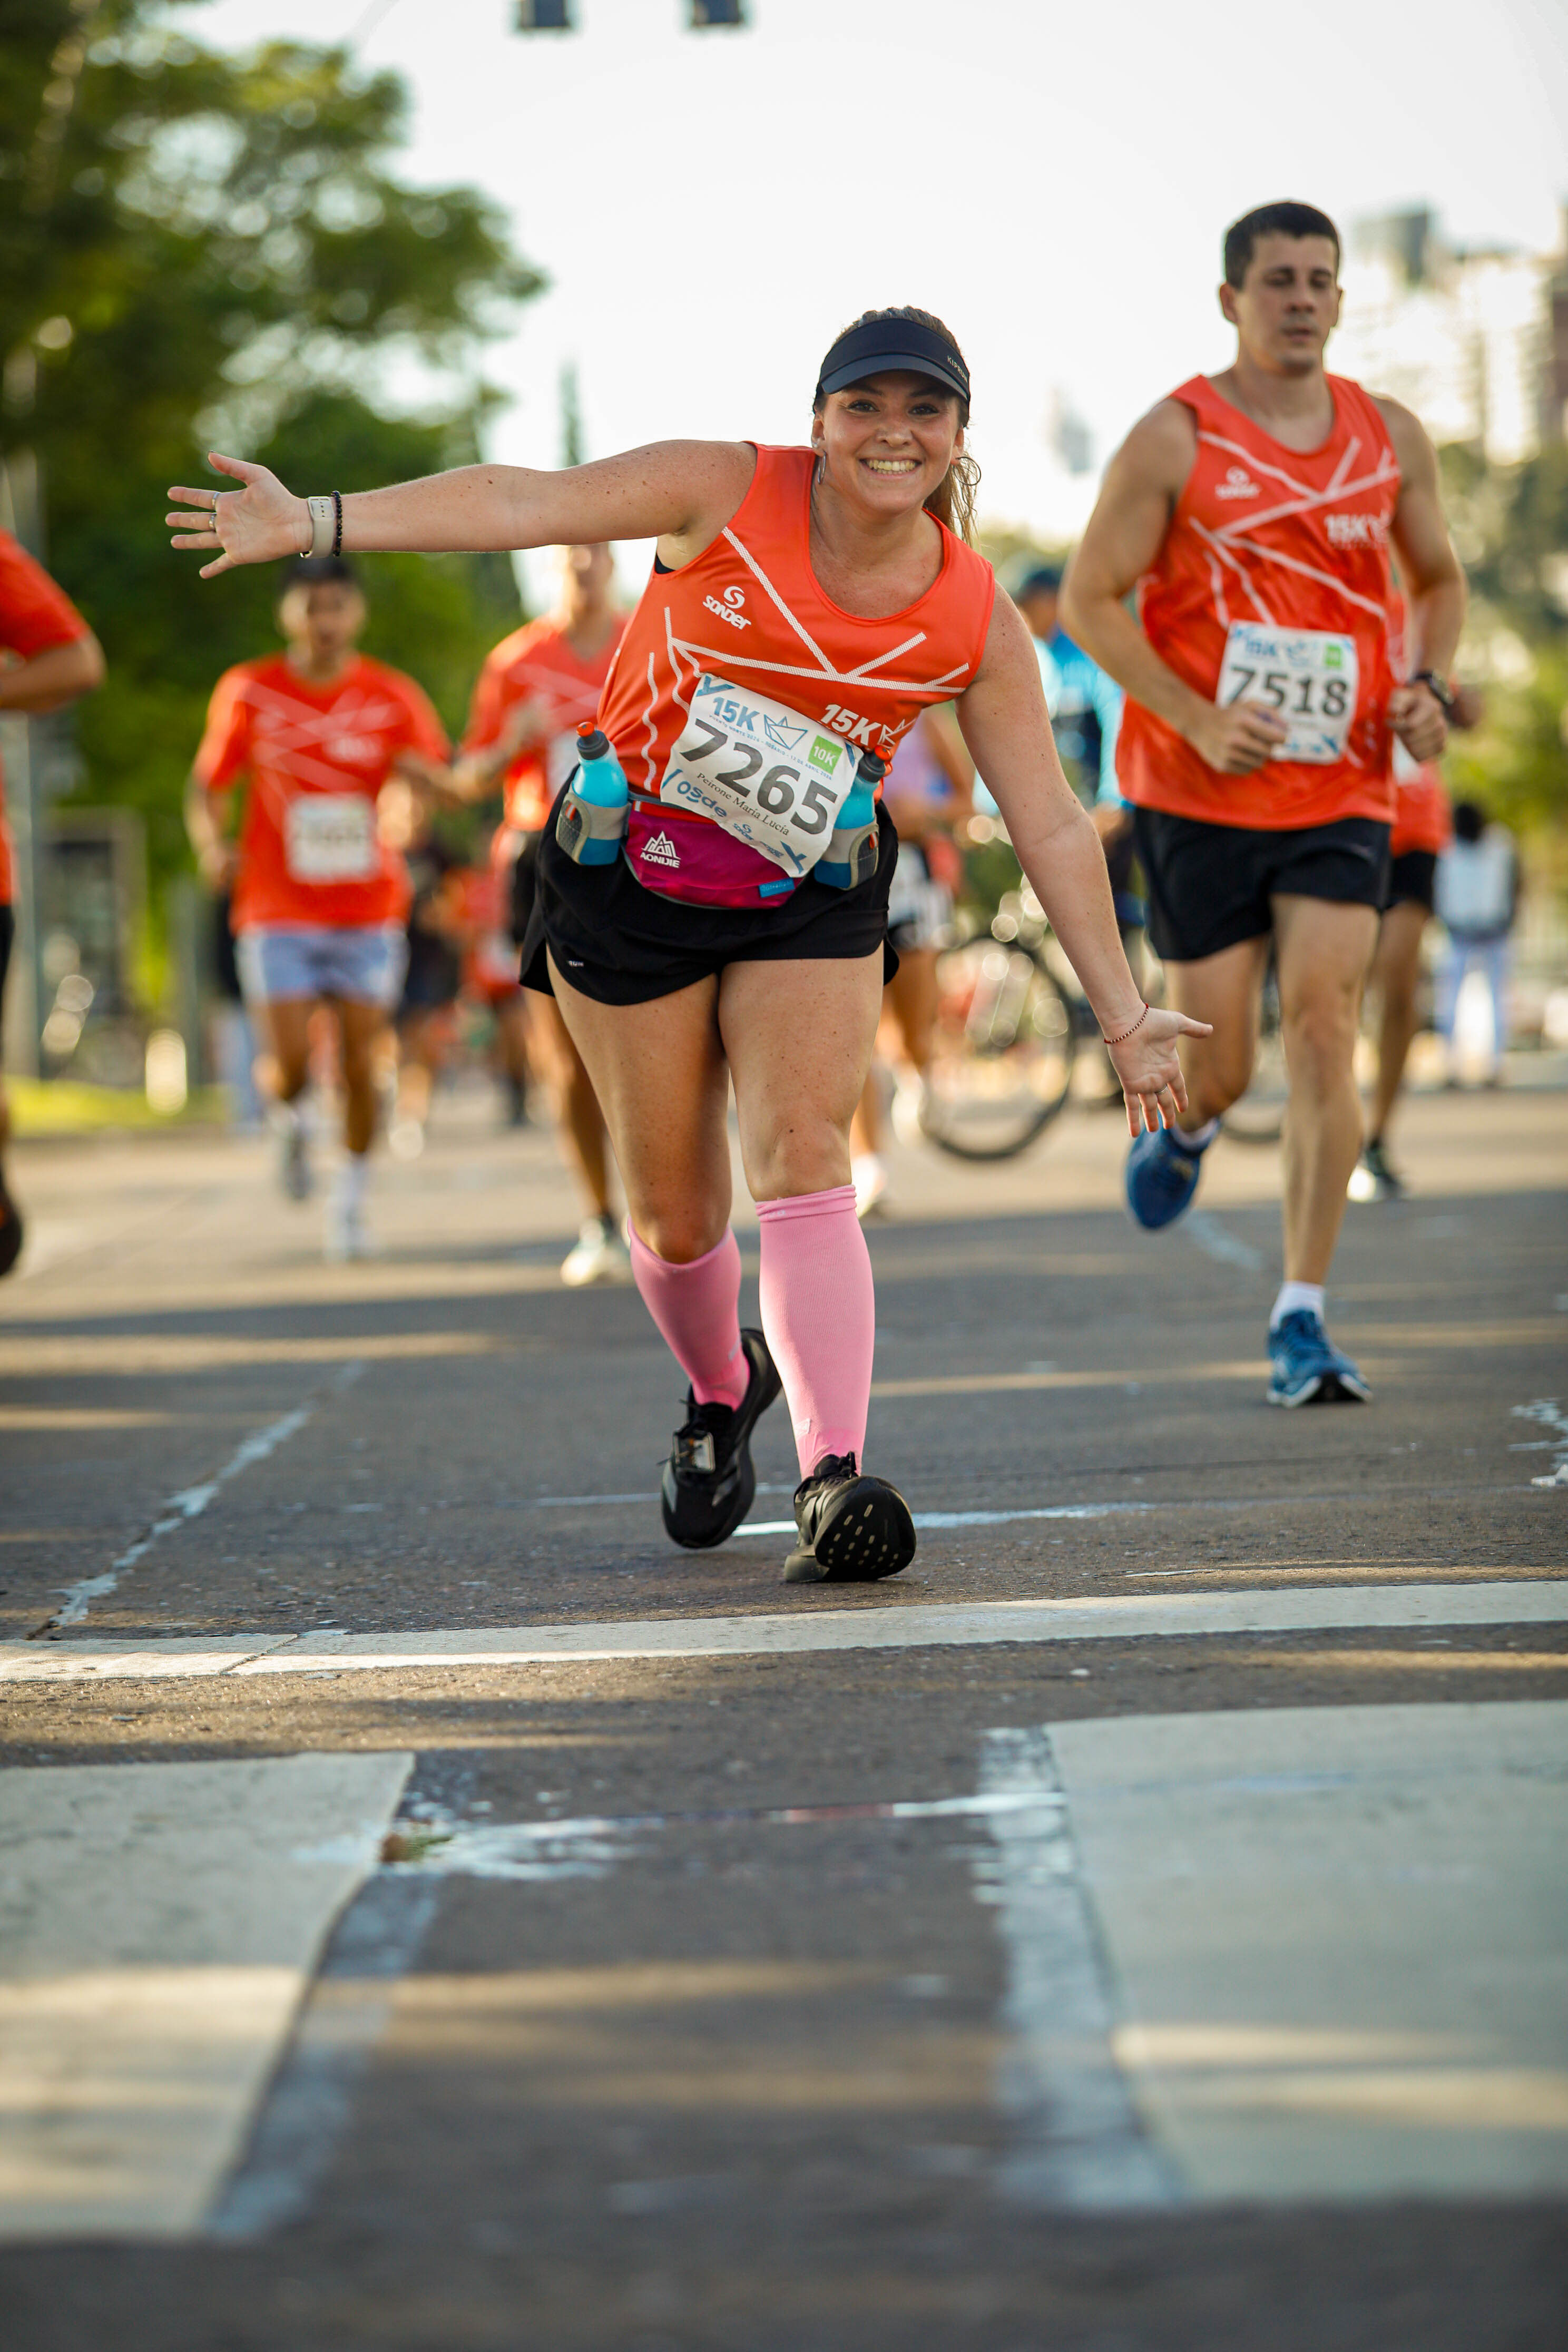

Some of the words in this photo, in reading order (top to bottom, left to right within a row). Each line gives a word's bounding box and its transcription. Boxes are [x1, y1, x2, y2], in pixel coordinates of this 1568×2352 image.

[1229, 664, 1348, 717] 7518
[713, 697, 760, 732] 15K
[820, 704, 881, 746] 15K
[679, 718, 838, 835] 7265
[814, 746, 837, 767] 10K
[697, 772, 732, 799] Peirone
[732, 797, 760, 819] María
[762, 815, 789, 836] Lucía
[640, 851, 680, 868] AONIJIE
